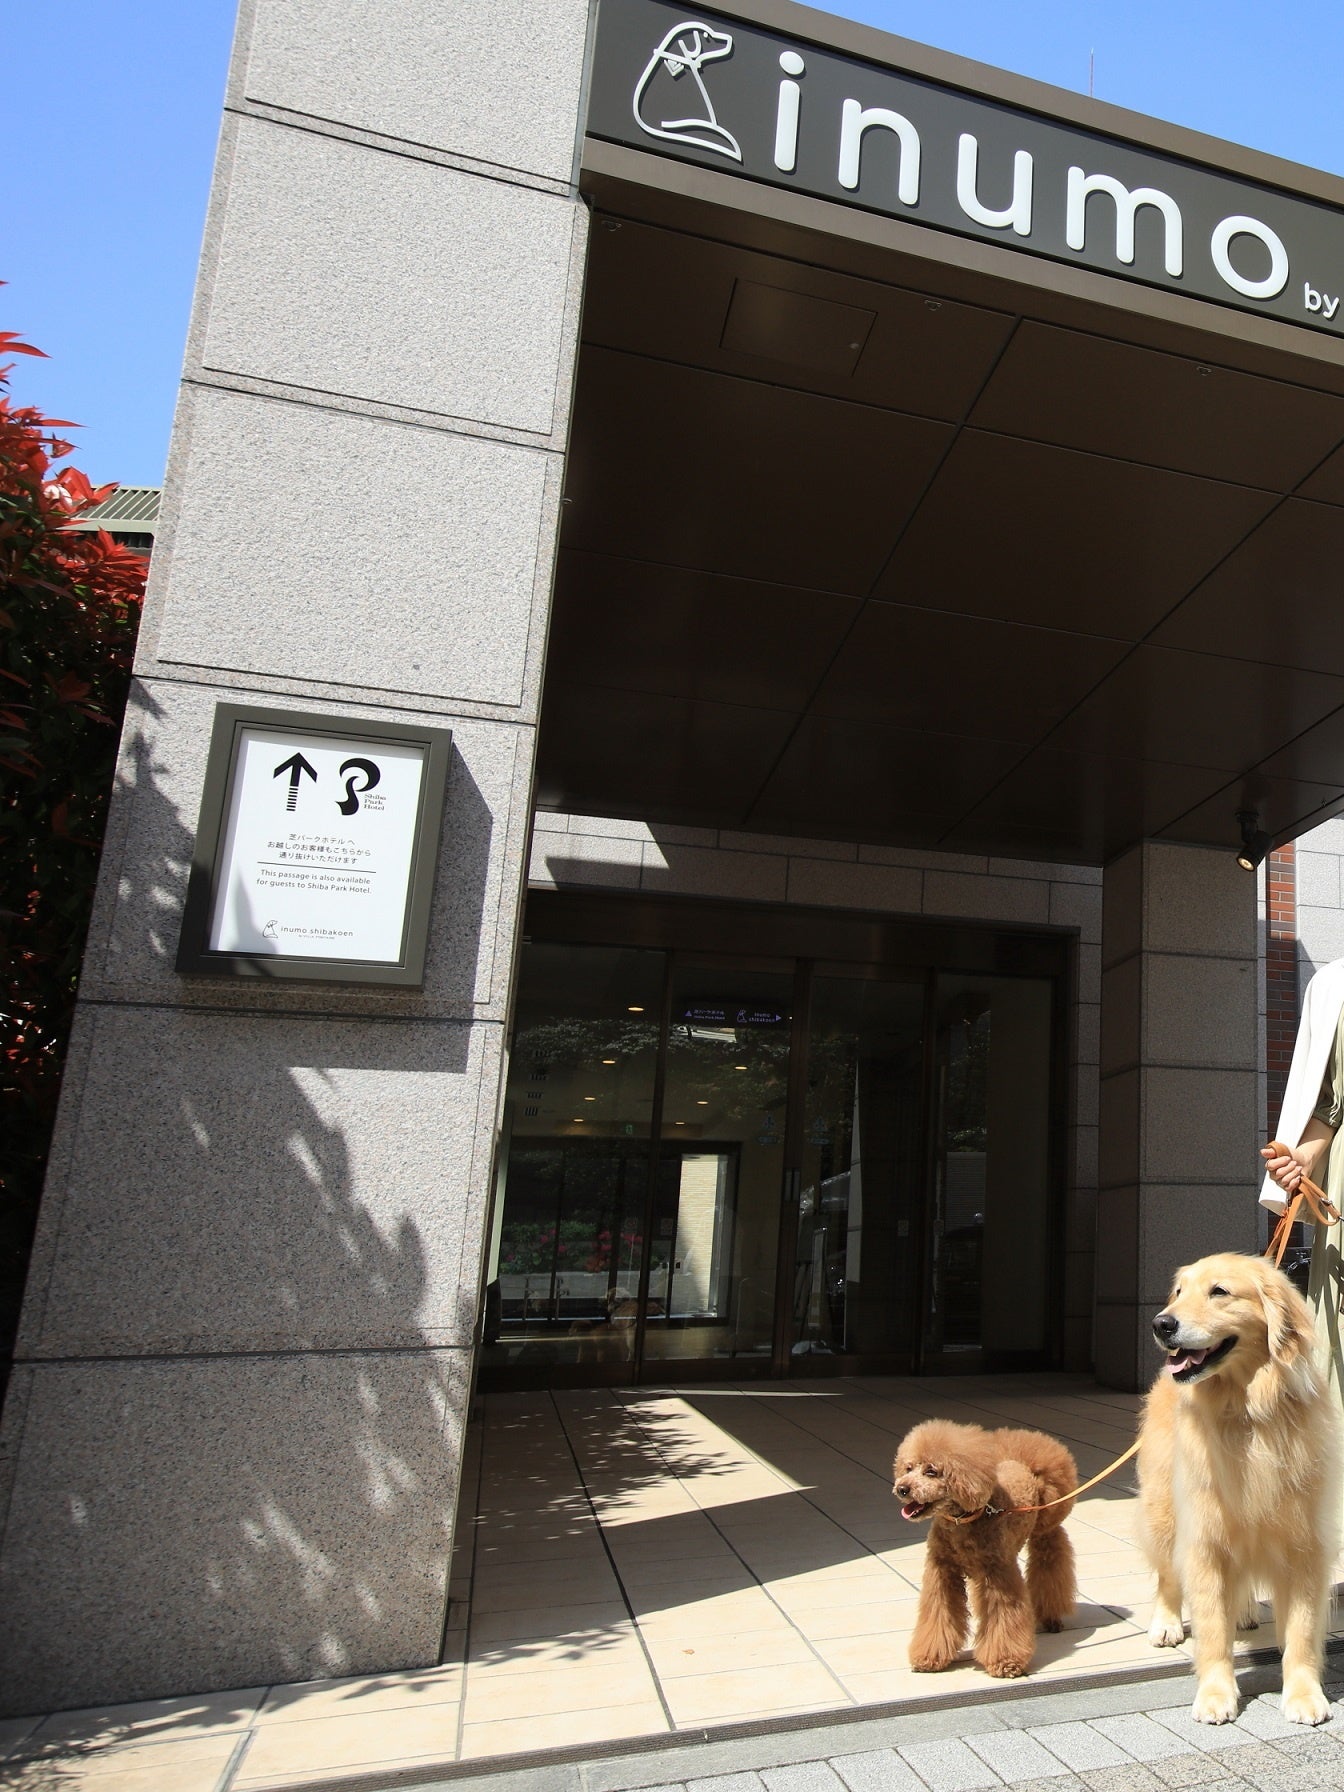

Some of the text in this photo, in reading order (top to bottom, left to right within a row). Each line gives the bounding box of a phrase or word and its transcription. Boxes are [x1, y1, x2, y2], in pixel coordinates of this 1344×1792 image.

[773, 50, 1289, 299] inumo
[1304, 282, 1339, 319] by
[261, 869, 276, 877] This
[278, 872, 310, 880] passage
[336, 876, 371, 885] available
[269, 880, 295, 888] guests
[307, 882, 329, 890] Shiba
[280, 926, 354, 936] inumo shibakoen
